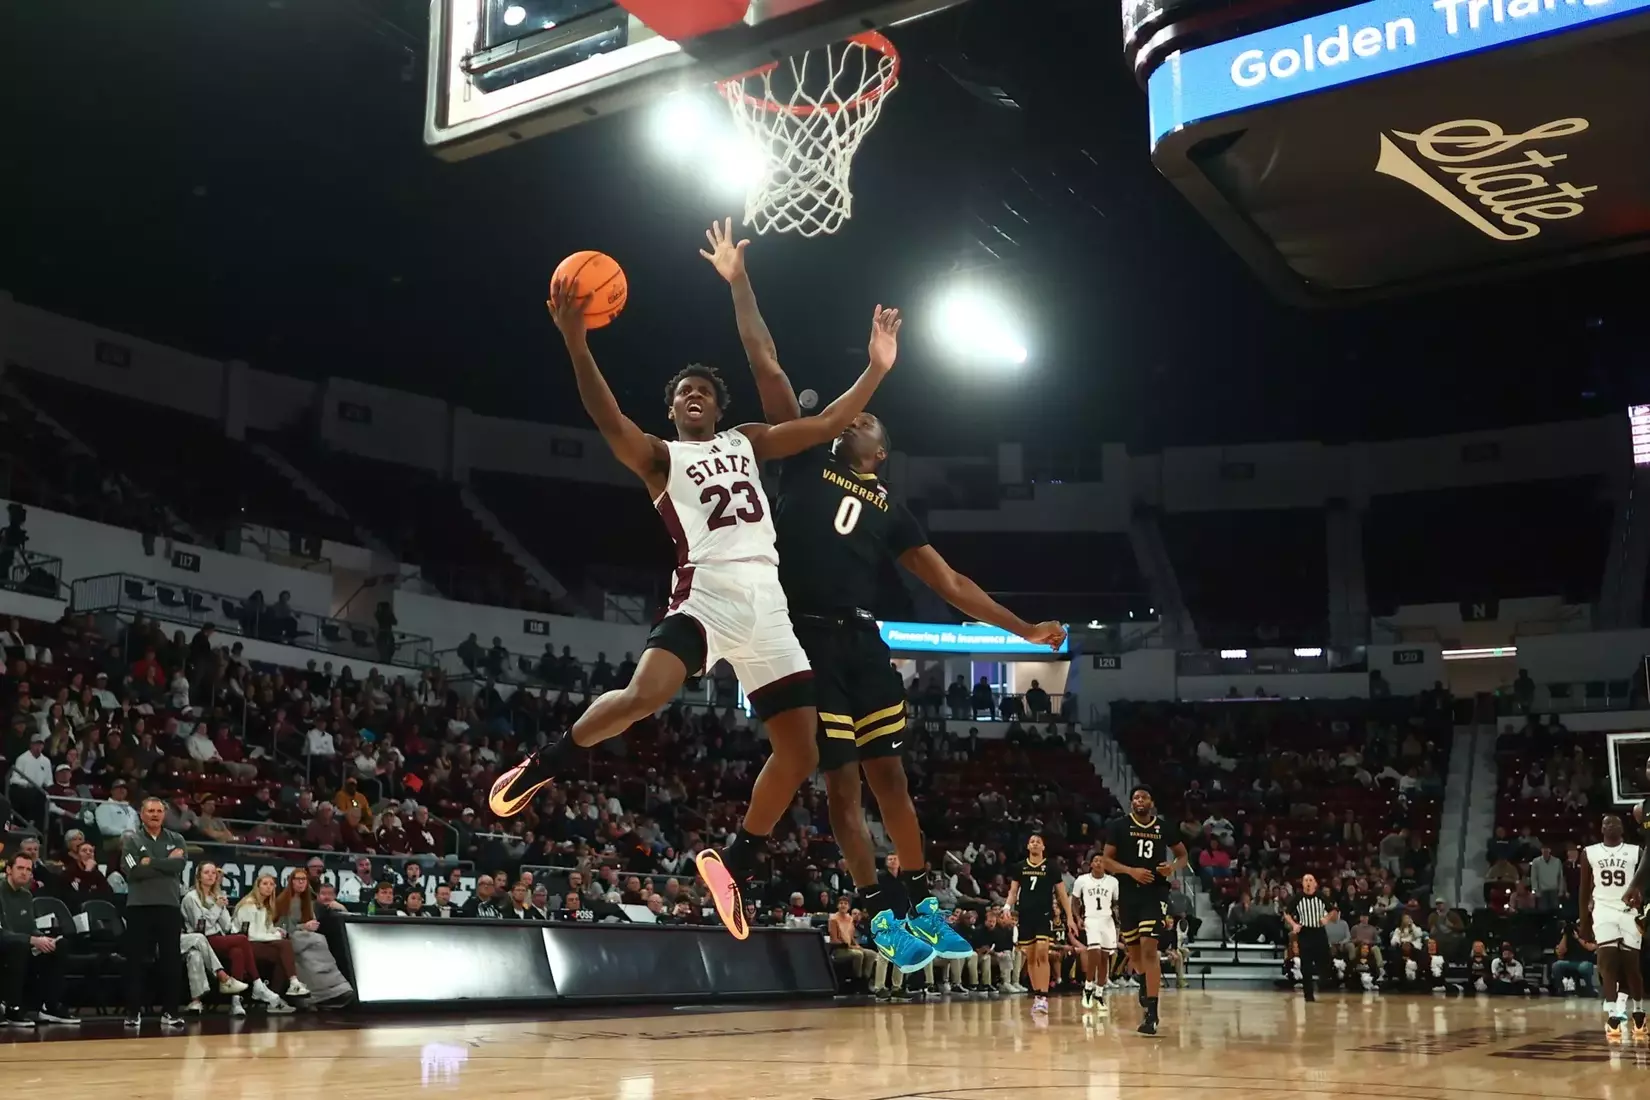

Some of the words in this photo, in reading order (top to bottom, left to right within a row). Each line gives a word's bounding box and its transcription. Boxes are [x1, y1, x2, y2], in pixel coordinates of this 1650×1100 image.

[1230, 15, 1416, 88] Golden
[1375, 117, 1598, 241] State
[686, 455, 750, 486] STATE
[822, 468, 888, 512] VANDERBILT
[699, 481, 764, 531] 23
[834, 495, 862, 535] 0
[179, 554, 192, 566] 117
[1099, 657, 1116, 668] 120
[1136, 839, 1154, 858] 13
[1598, 859, 1627, 868] STATE
[1030, 876, 1038, 890] 7
[1601, 870, 1625, 886] 99
[1088, 888, 1108, 897] STATE
[1096, 898, 1102, 910] 1
[575, 910, 593, 919] POSS
